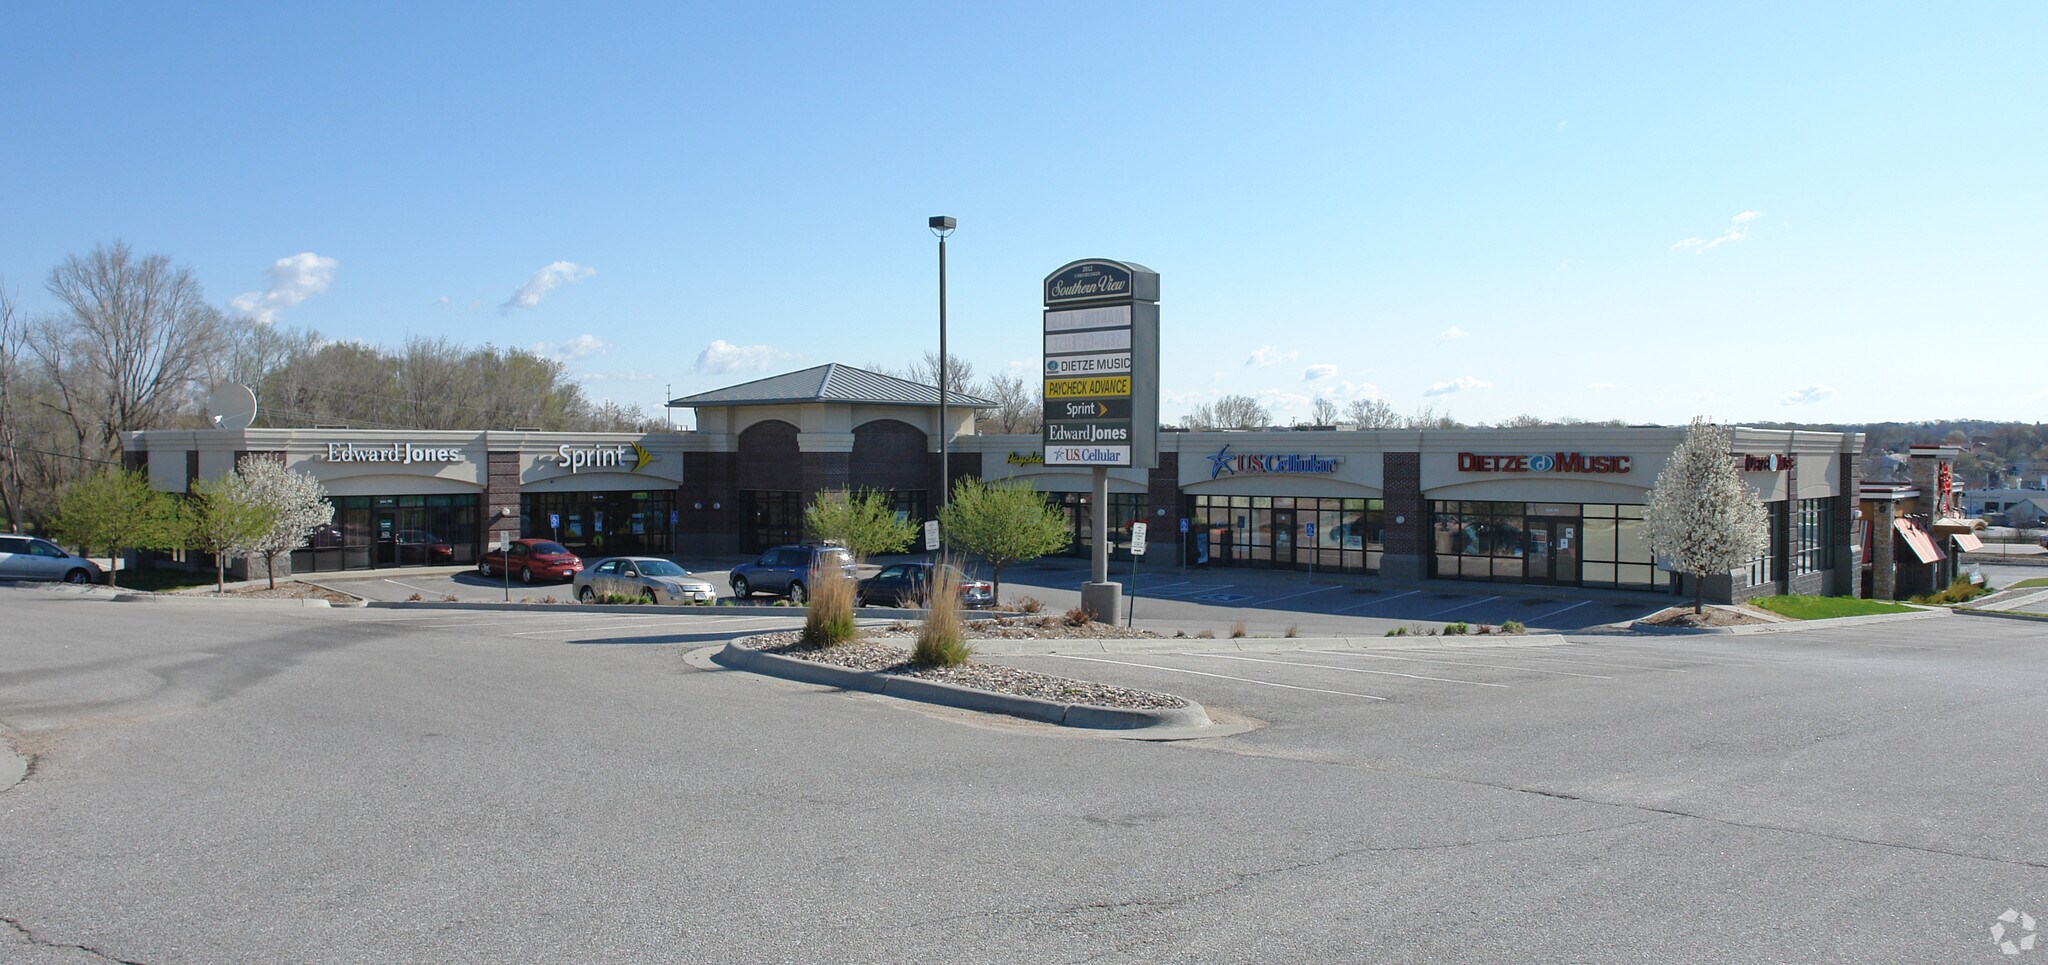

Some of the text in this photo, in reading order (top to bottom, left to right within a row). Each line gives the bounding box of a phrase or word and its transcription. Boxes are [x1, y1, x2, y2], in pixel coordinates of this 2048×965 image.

[1051, 275, 1126, 297] Southern View
[1061, 357, 1131, 372] DIETZE MUSIC
[1049, 379, 1127, 395] PAYCHECK ADVANCE
[1066, 402, 1095, 418] Sprint
[1049, 424, 1127, 442] Edward Jones
[327, 442, 460, 465] Edward Jones
[558, 444, 626, 474] Sprint
[1082, 448, 1121, 462] Cellular
[1264, 454, 1336, 473] Cellular
[1458, 452, 1527, 473] DIETZE
[1555, 452, 1630, 474] MUSIC
